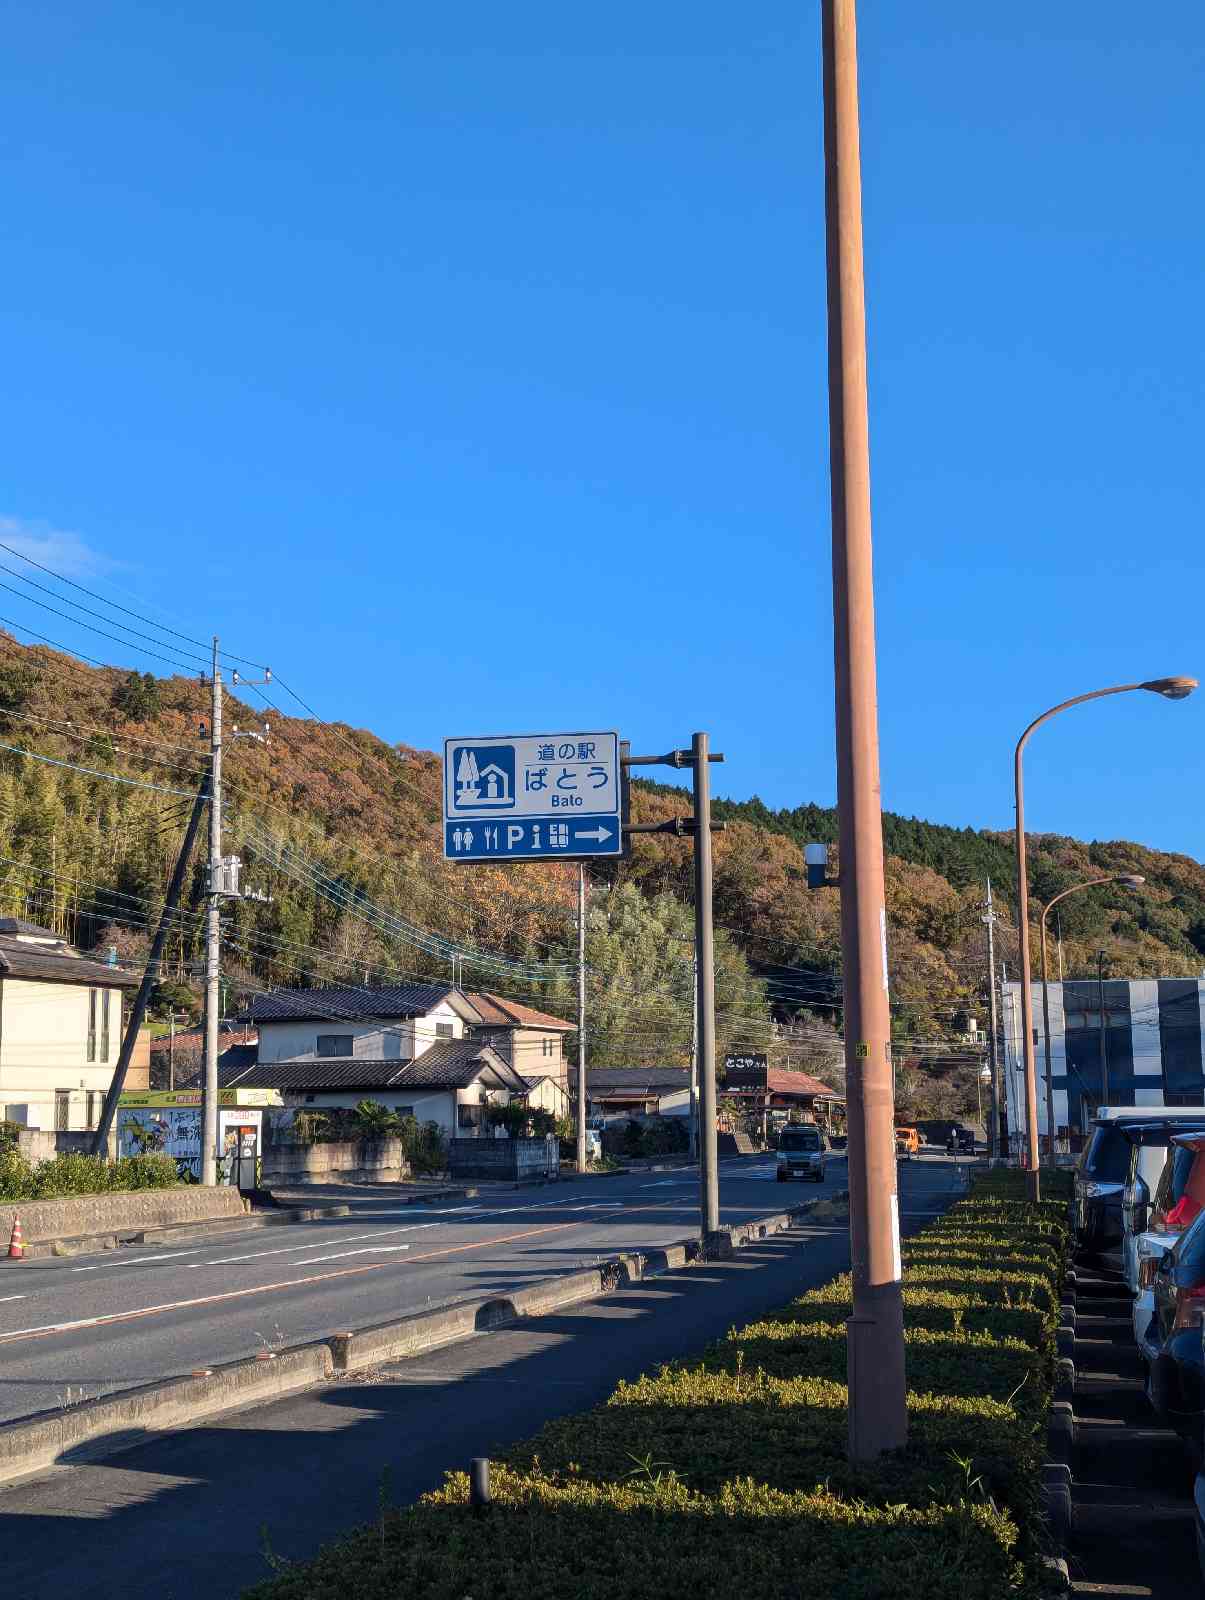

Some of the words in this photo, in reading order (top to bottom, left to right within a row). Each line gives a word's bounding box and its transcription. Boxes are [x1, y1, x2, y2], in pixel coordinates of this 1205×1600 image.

[538, 742, 596, 761] 道の駅
[525, 767, 608, 791] ばとう
[551, 794, 583, 808] Bato
[507, 825, 525, 850] P
